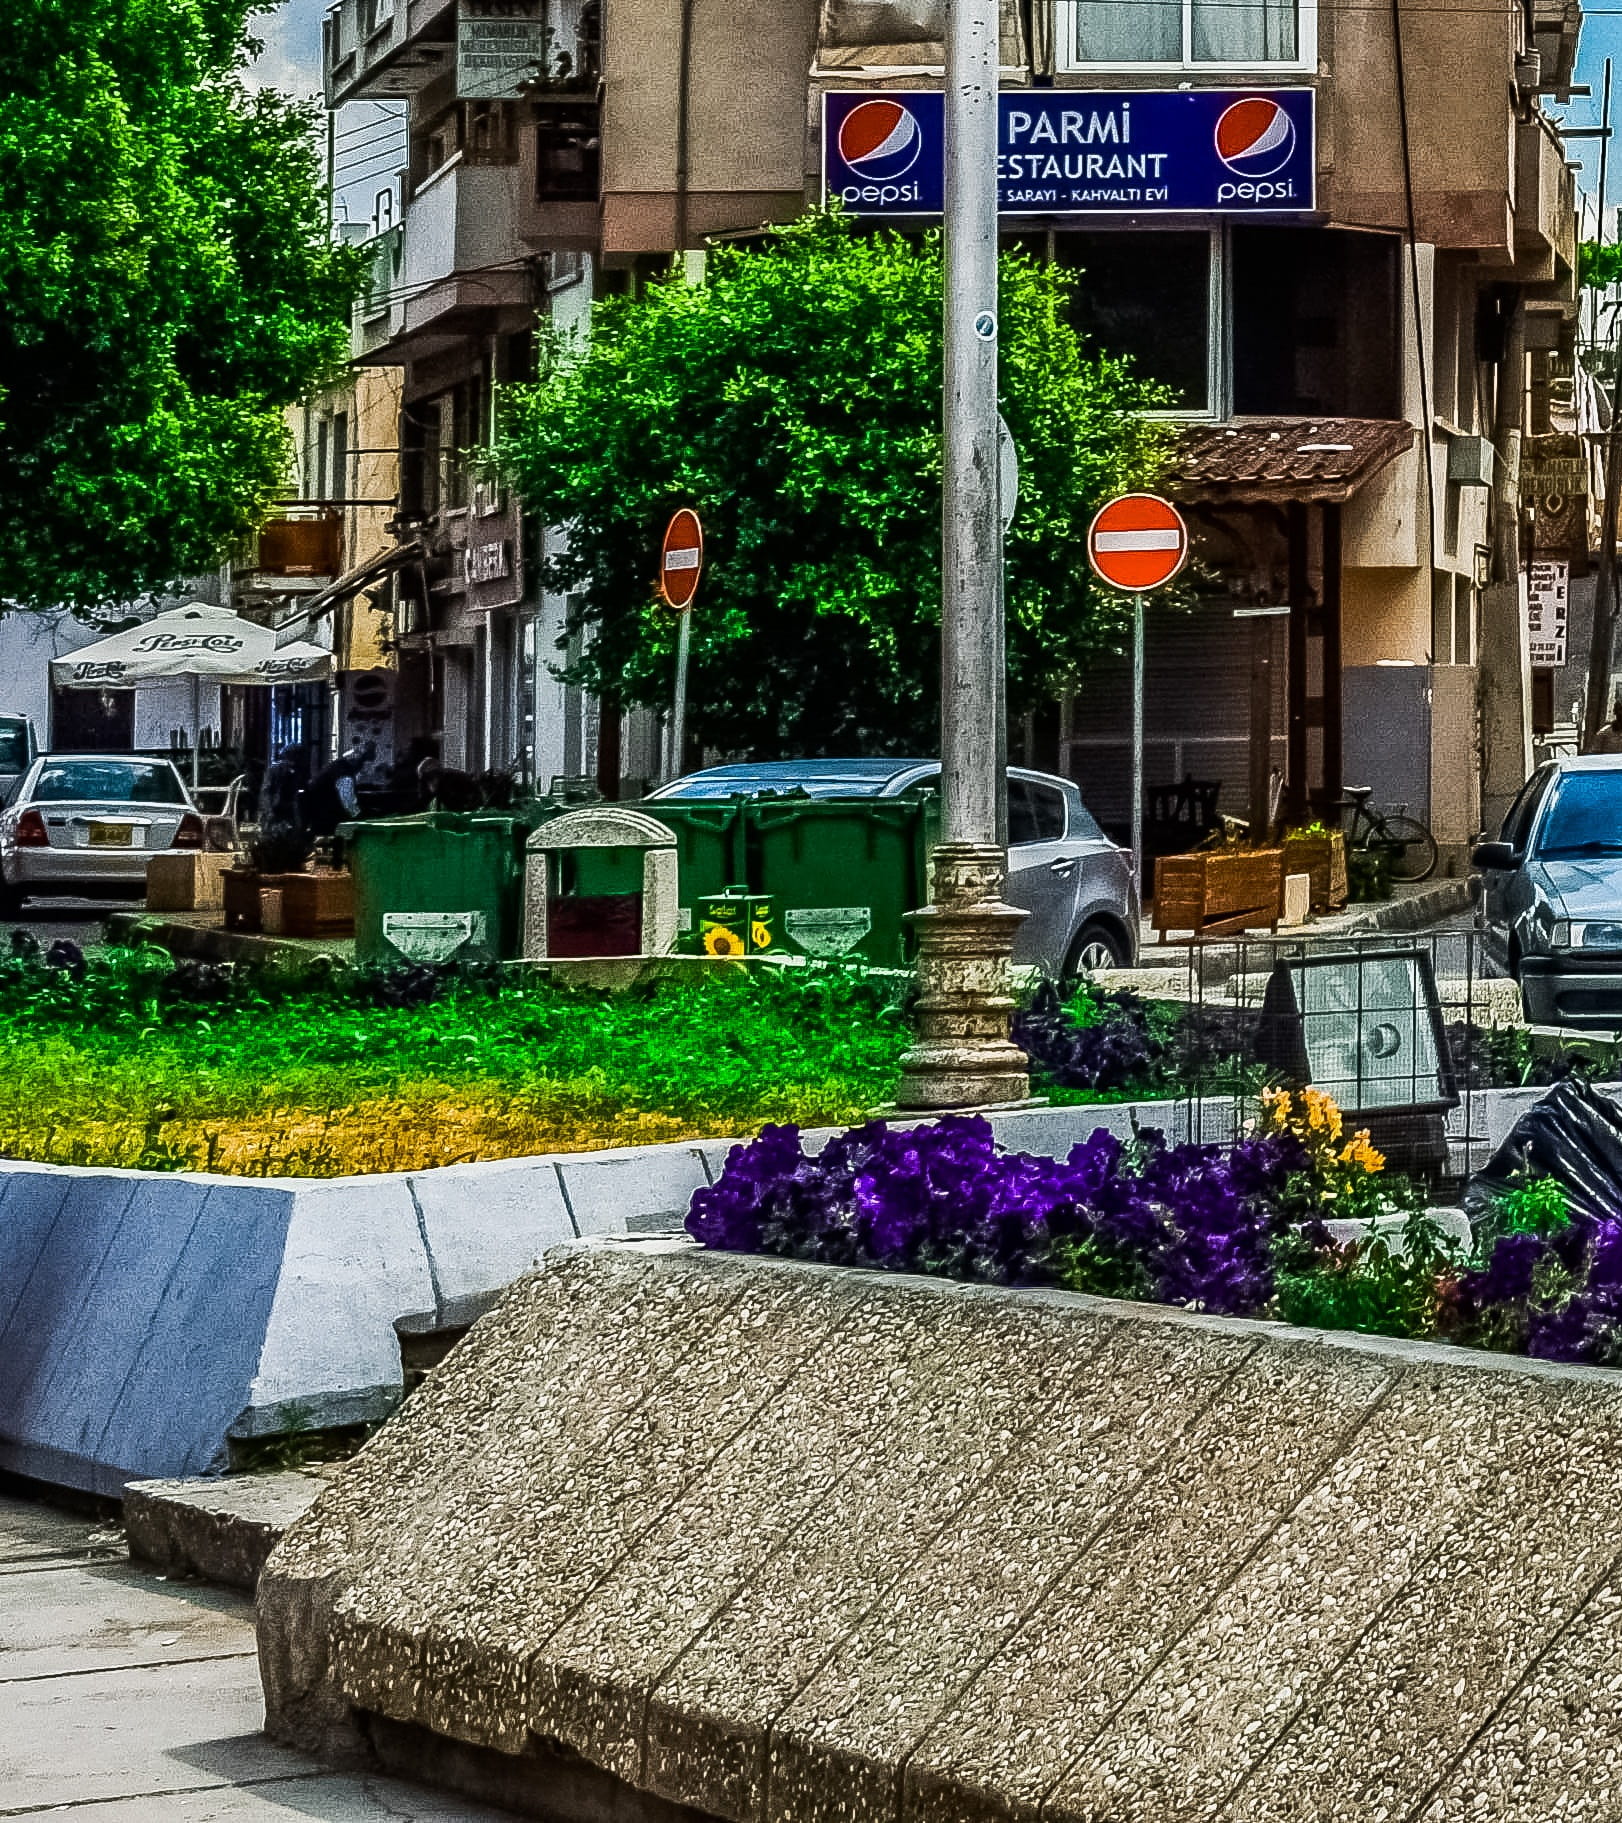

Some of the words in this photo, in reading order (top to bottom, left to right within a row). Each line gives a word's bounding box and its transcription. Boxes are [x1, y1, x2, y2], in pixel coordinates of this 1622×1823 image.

[997, 154, 1168, 179] ESTAURANT
[842, 181, 919, 206] pepsi
[1007, 188, 1057, 202] SARAYI
[1071, 188, 1141, 201] KAHVALTI
[1217, 178, 1293, 203] pepsi
